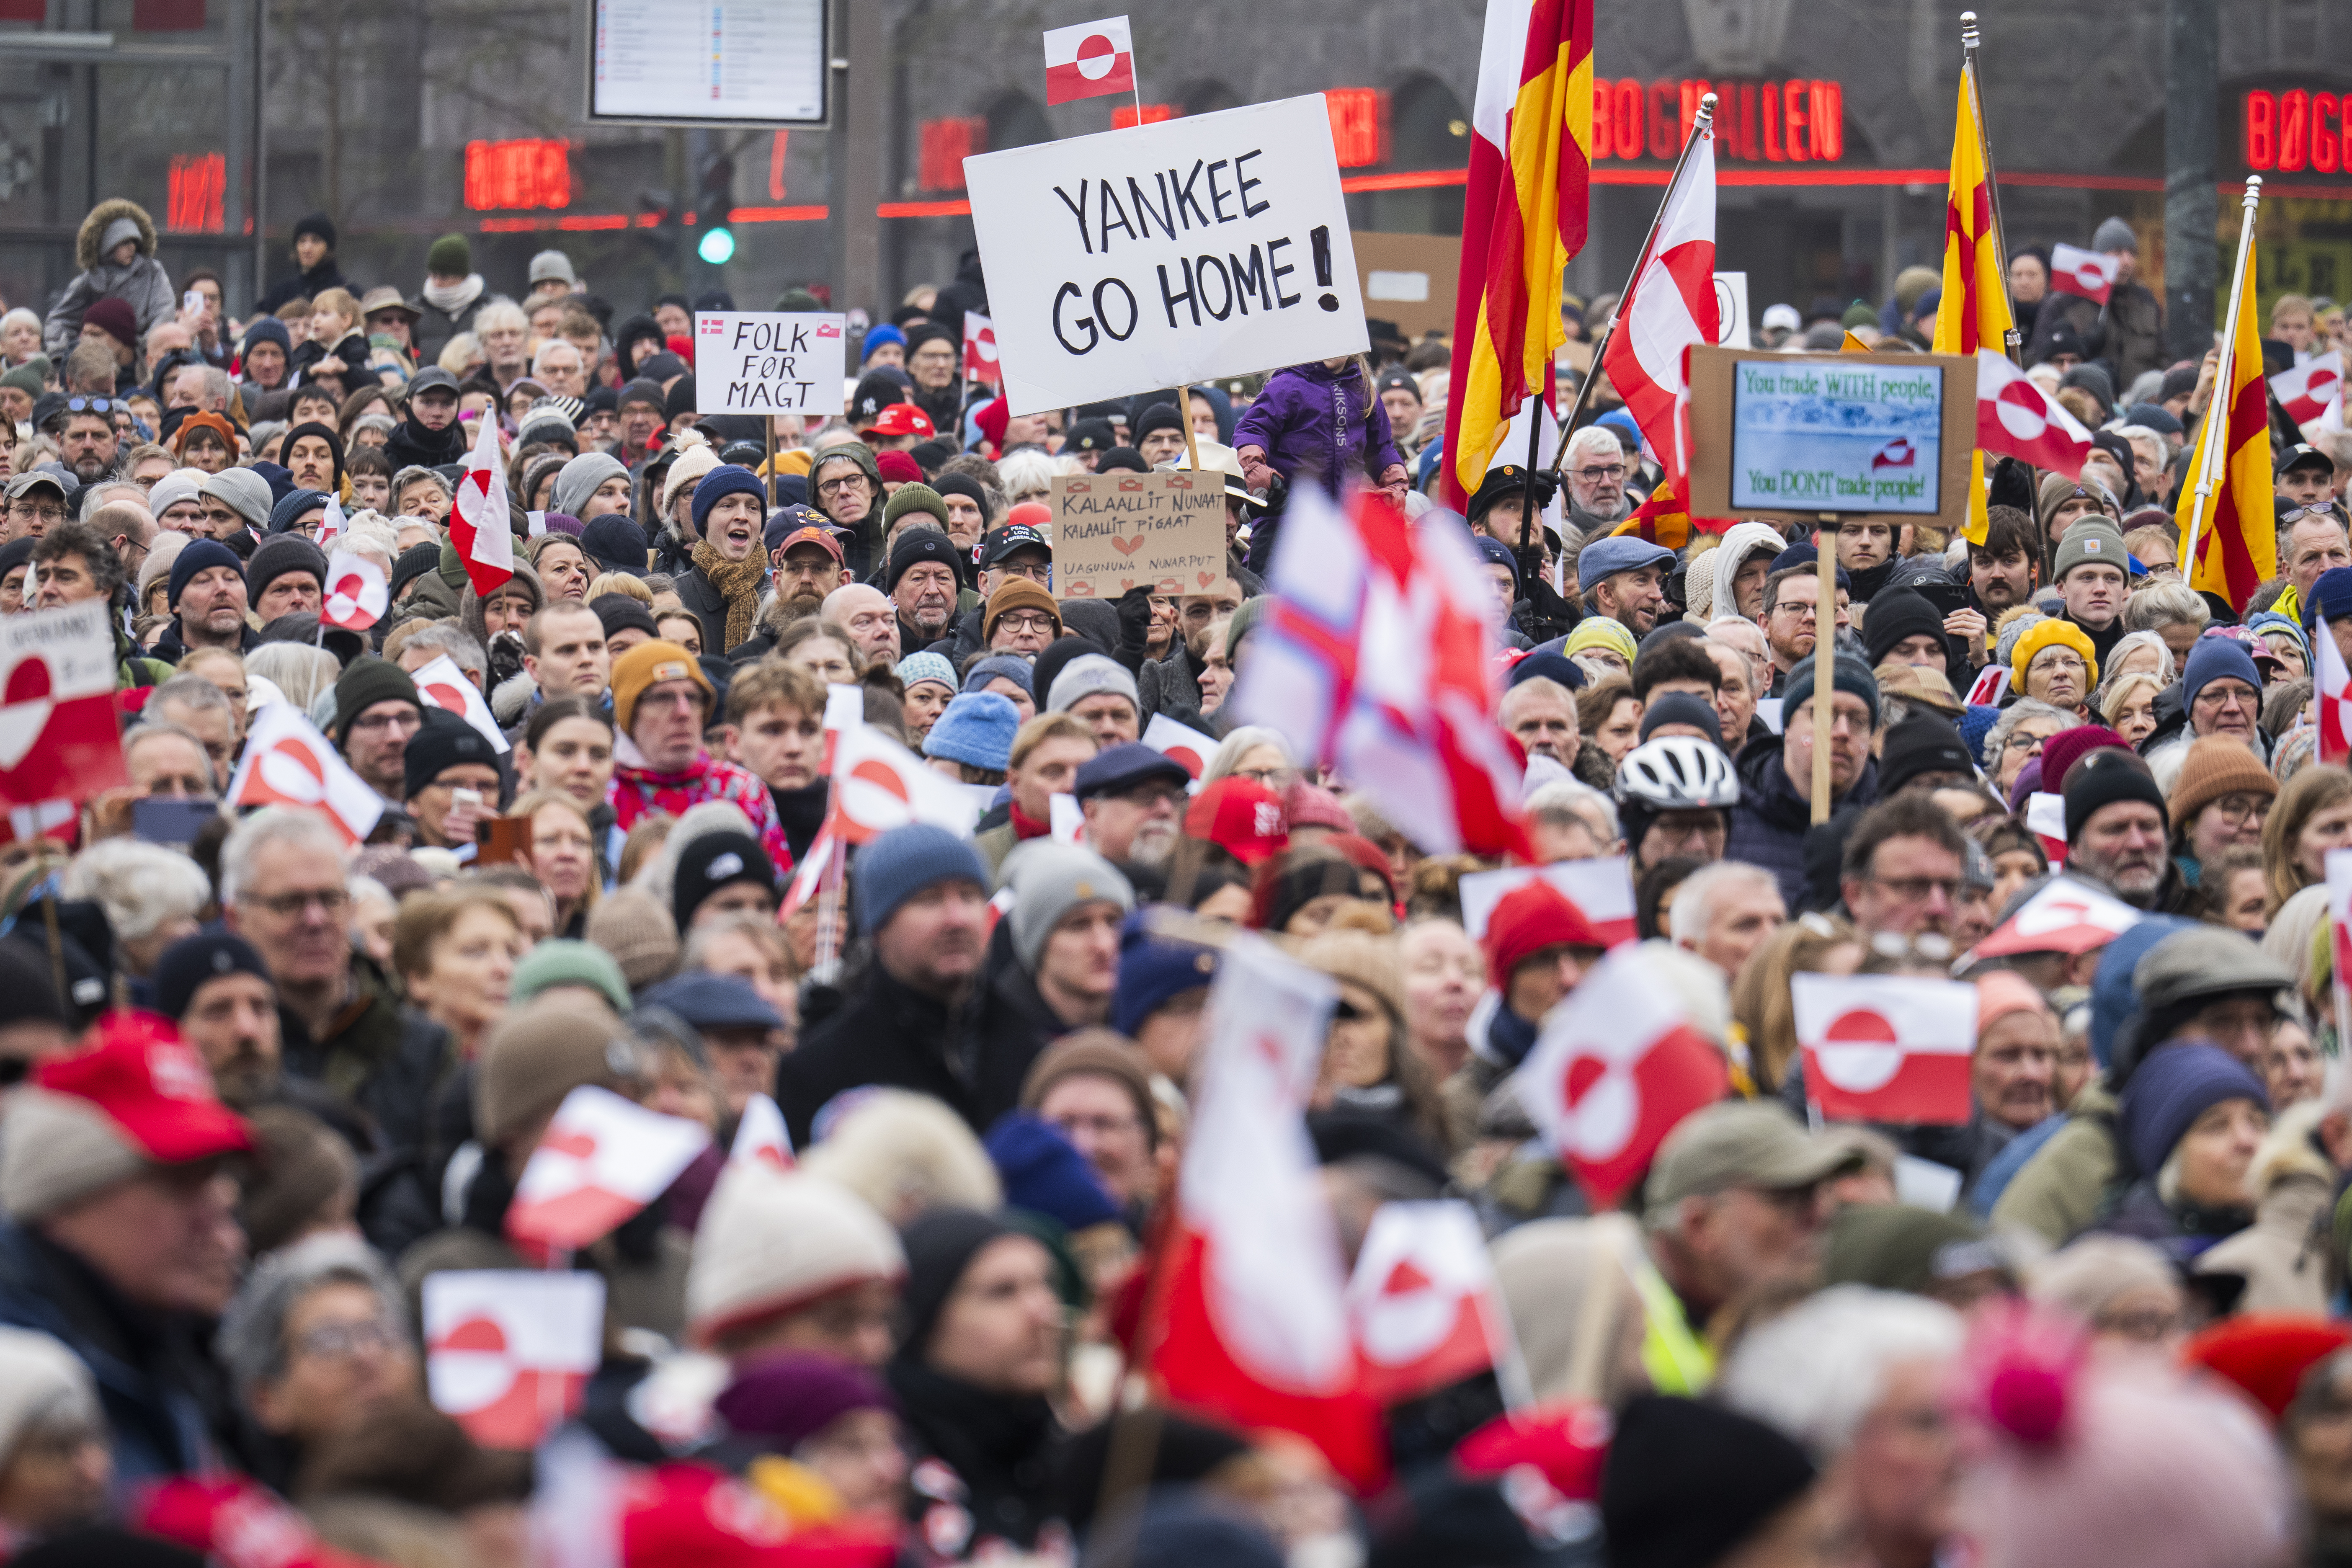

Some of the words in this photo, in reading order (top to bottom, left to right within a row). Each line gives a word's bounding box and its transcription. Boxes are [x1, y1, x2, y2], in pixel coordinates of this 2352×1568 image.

[1053, 149, 1270, 254] YANKEE
[1052, 277, 1138, 355] GO
[1156, 224, 1339, 328] HOME!
[734, 321, 809, 353] FOLK
[742, 356, 795, 379] FØR
[727, 382, 815, 408] MAGT
[1743, 369, 1775, 393] You
[1779, 371, 1818, 394] trade
[1824, 372, 1876, 397] WITH
[1880, 374, 1934, 404] people,
[1172, 488, 1224, 512] NUNAAT
[1747, 469, 1776, 493] You
[1781, 470, 1833, 495] DONT
[1836, 472, 1871, 495] trade
[1874, 473, 1926, 503] people!
[1064, 560, 1135, 575] UAGUNUNA
[1148, 555, 1215, 570] NUNARPUT
